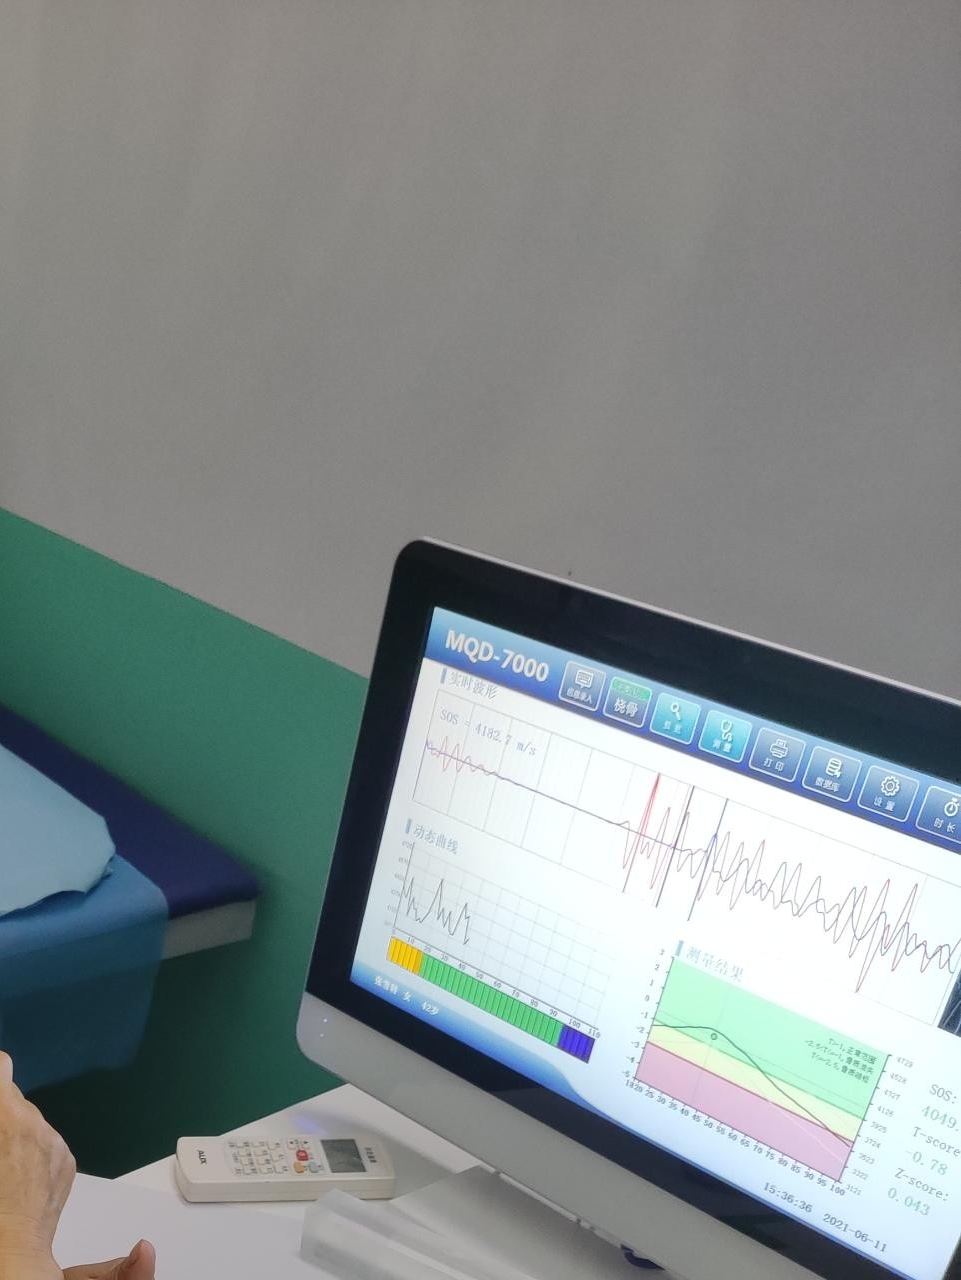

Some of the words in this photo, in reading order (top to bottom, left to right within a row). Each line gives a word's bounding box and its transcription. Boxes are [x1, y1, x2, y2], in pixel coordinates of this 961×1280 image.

[445, 629, 549, 683] MQD-7000
[439, 709, 459, 725] SOS
[764, 758, 784, 772] 打印
[815, 778, 839, 793] 数据库
[874, 797, 895, 812] 设置
[414, 824, 458, 855] 动态曲线
[929, 1083, 957, 1104] SOS:
[645, 1089, 654, 1098] 25
[657, 1095, 666, 1105] 30
[668, 1101, 678, 1110] 35
[680, 1107, 689, 1117] 40
[692, 1113, 701, 1123] 45
[704, 1119, 713, 1129] 50
[716, 1125, 726, 1135] 55
[728, 1131, 737, 1141] 60
[740, 1138, 750, 1148] 65
[753, 1144, 762, 1154] 70
[766, 1150, 775, 1161] 75
[778, 1157, 788, 1167] 80
[791, 1164, 800, 1174] 85
[804, 1170, 813, 1180] 90
[817, 1177, 827, 1187] 95
[830, 1183, 845, 1196] 100
[894, 1167, 949, 1201] Z-score:
[888, 1187, 930, 1216] 0.043
[763, 1182, 813, 1213] 15:36:36
[823, 1213, 887, 1252] 2021-06-11
